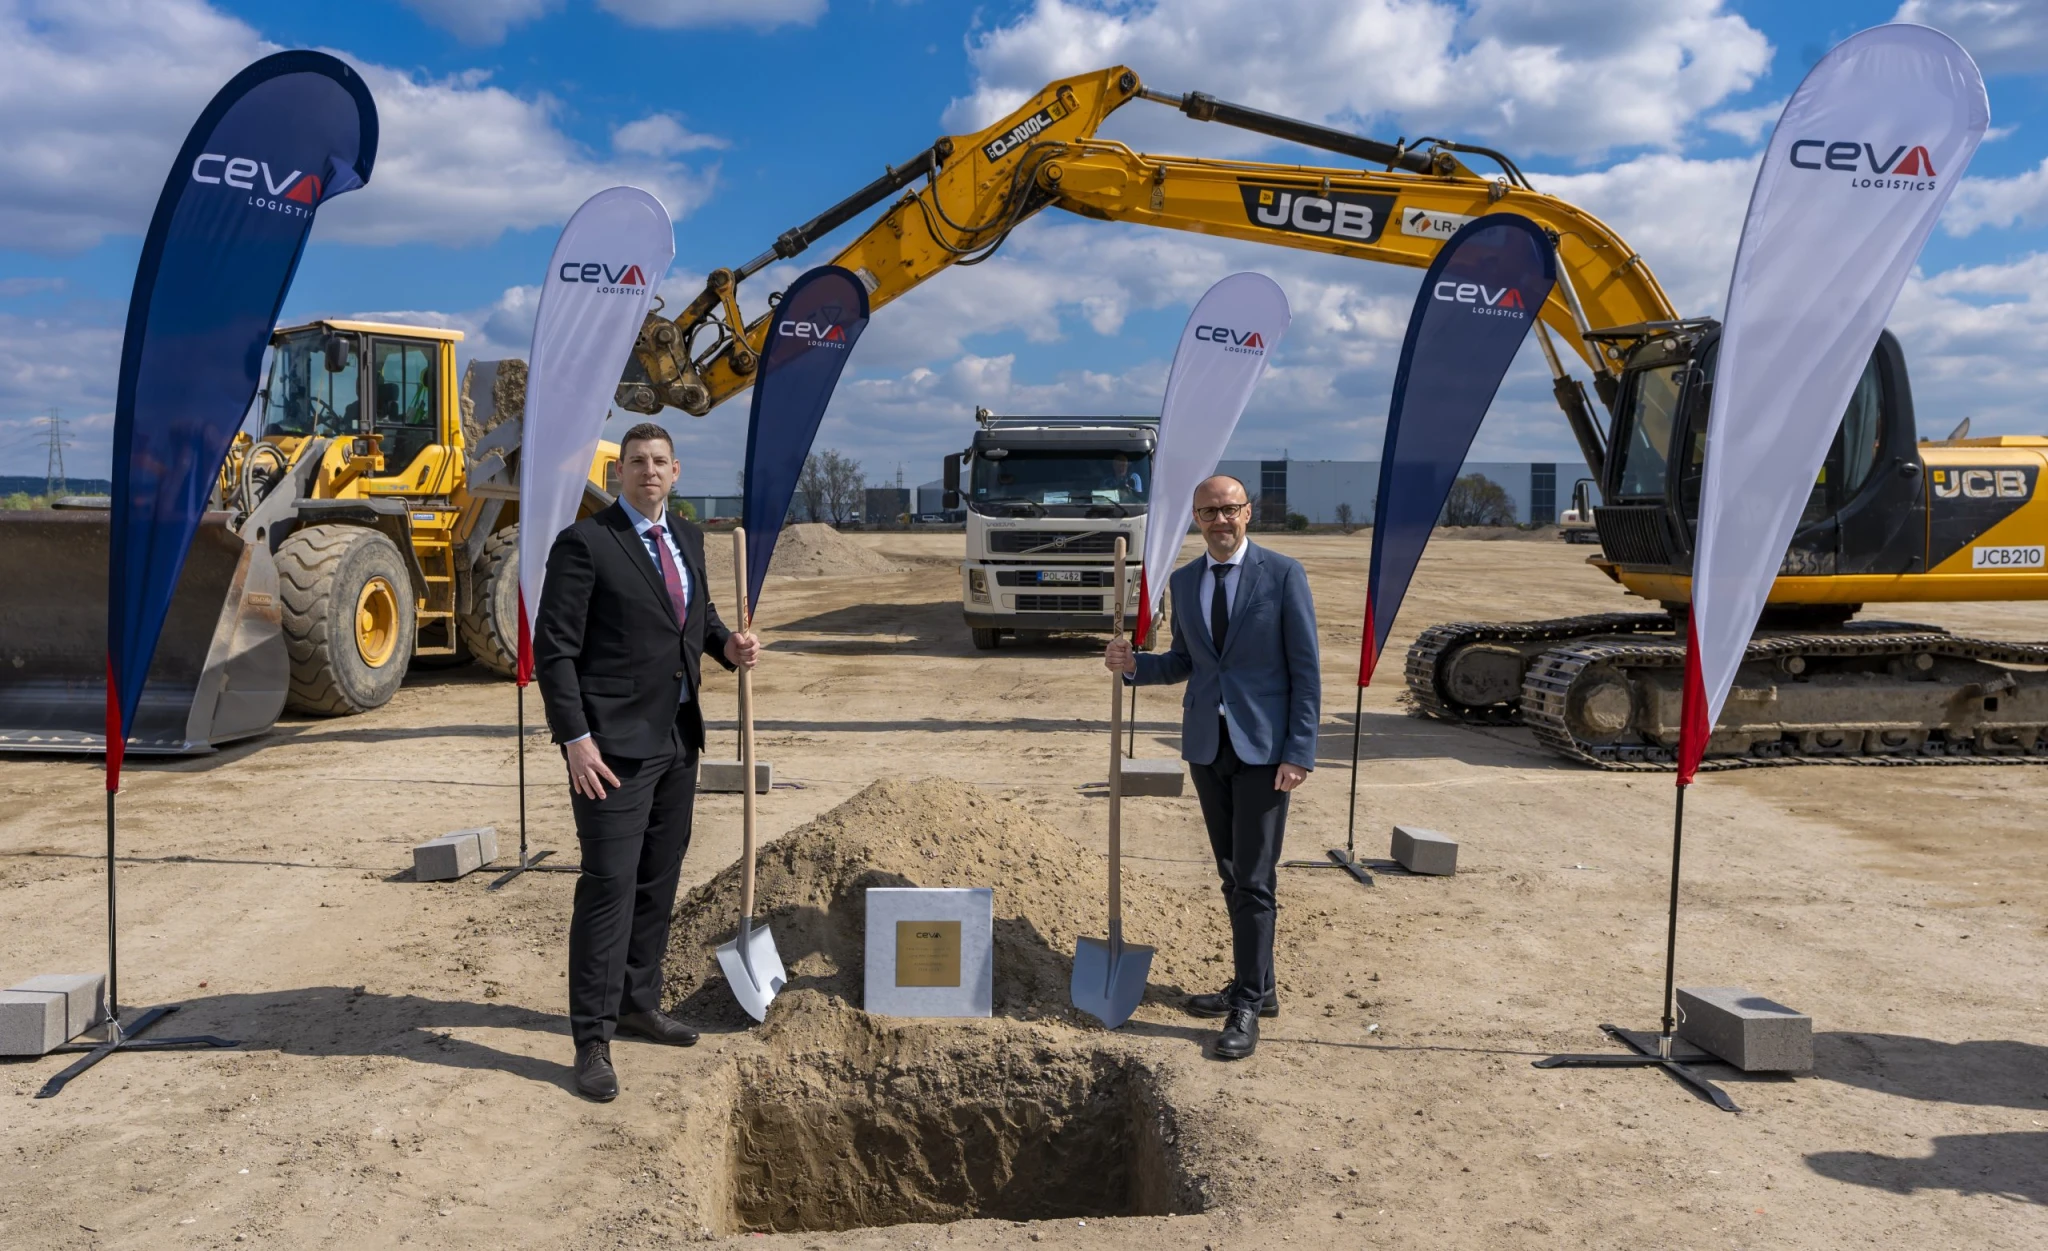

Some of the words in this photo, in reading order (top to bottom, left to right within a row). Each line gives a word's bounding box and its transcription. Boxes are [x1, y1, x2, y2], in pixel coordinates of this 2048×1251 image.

[1851, 178, 1936, 191] LOGISTICS
[248, 196, 312, 219] LOGISTI
[1257, 192, 1374, 239] JCB
[596, 286, 645, 296] LOGISTICS
[1472, 306, 1524, 319] LOGISTICS
[1224, 346, 1264, 356] LOGISTICS
[1934, 470, 2028, 498] JCB
[1977, 549, 2041, 565] JCB210
